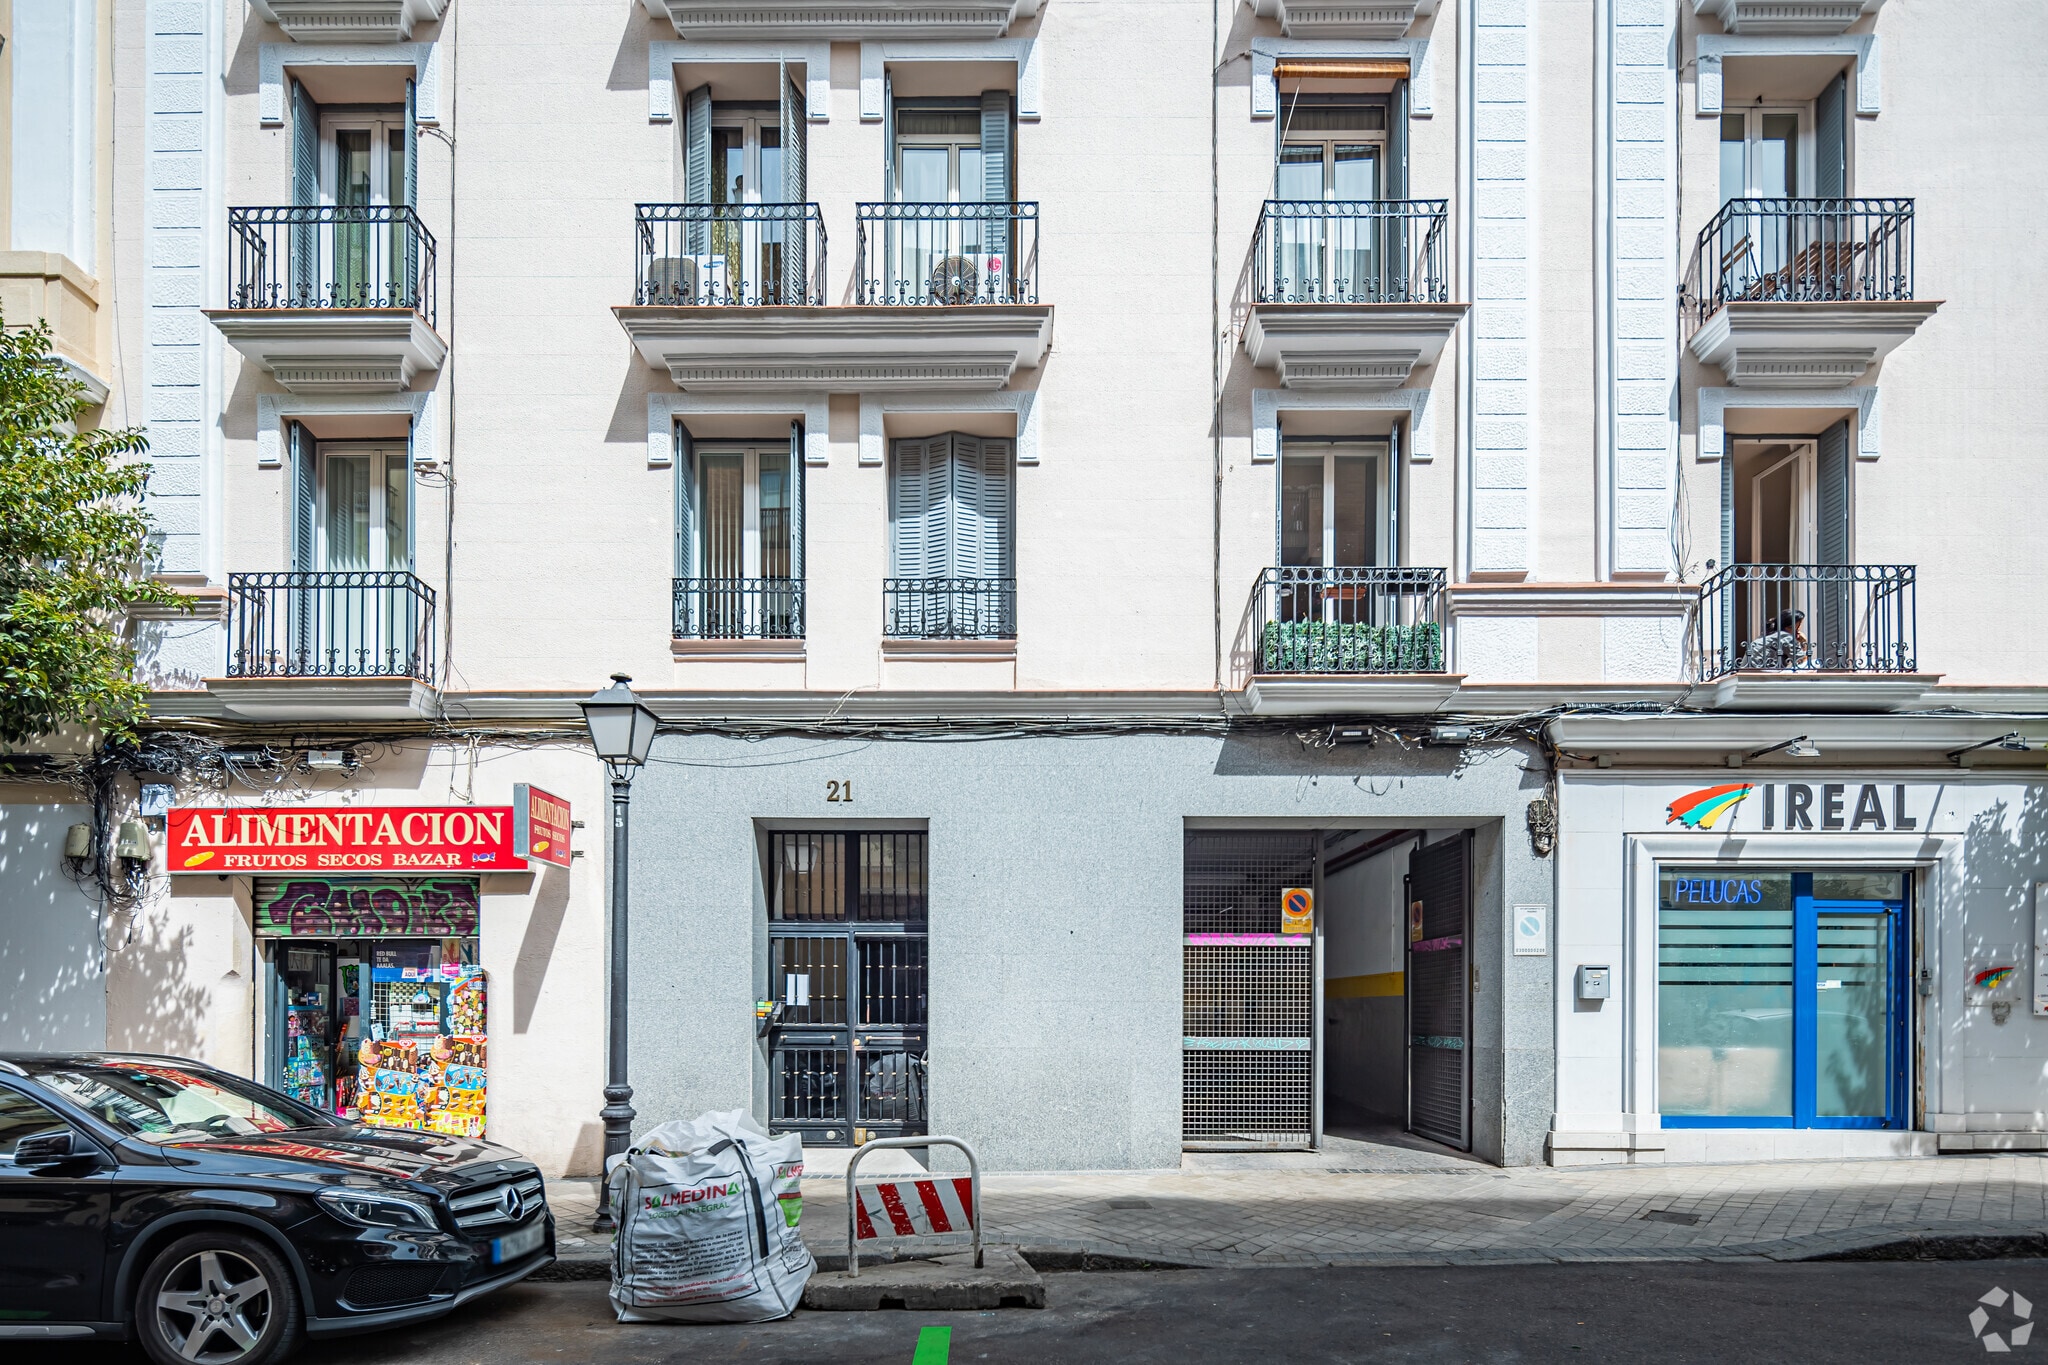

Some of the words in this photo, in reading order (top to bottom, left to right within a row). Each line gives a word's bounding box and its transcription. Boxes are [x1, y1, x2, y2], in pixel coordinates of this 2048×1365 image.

[826, 780, 853, 802] 21
[531, 795, 570, 831] ALIMENTACION
[1762, 783, 1917, 830] IREAL
[181, 812, 504, 846] ALIMENTACION
[224, 854, 307, 867] FRUTOS
[317, 853, 383, 866] SECOS
[392, 852, 463, 867] BAZAR
[1675, 879, 1762, 904] PELUCAS
